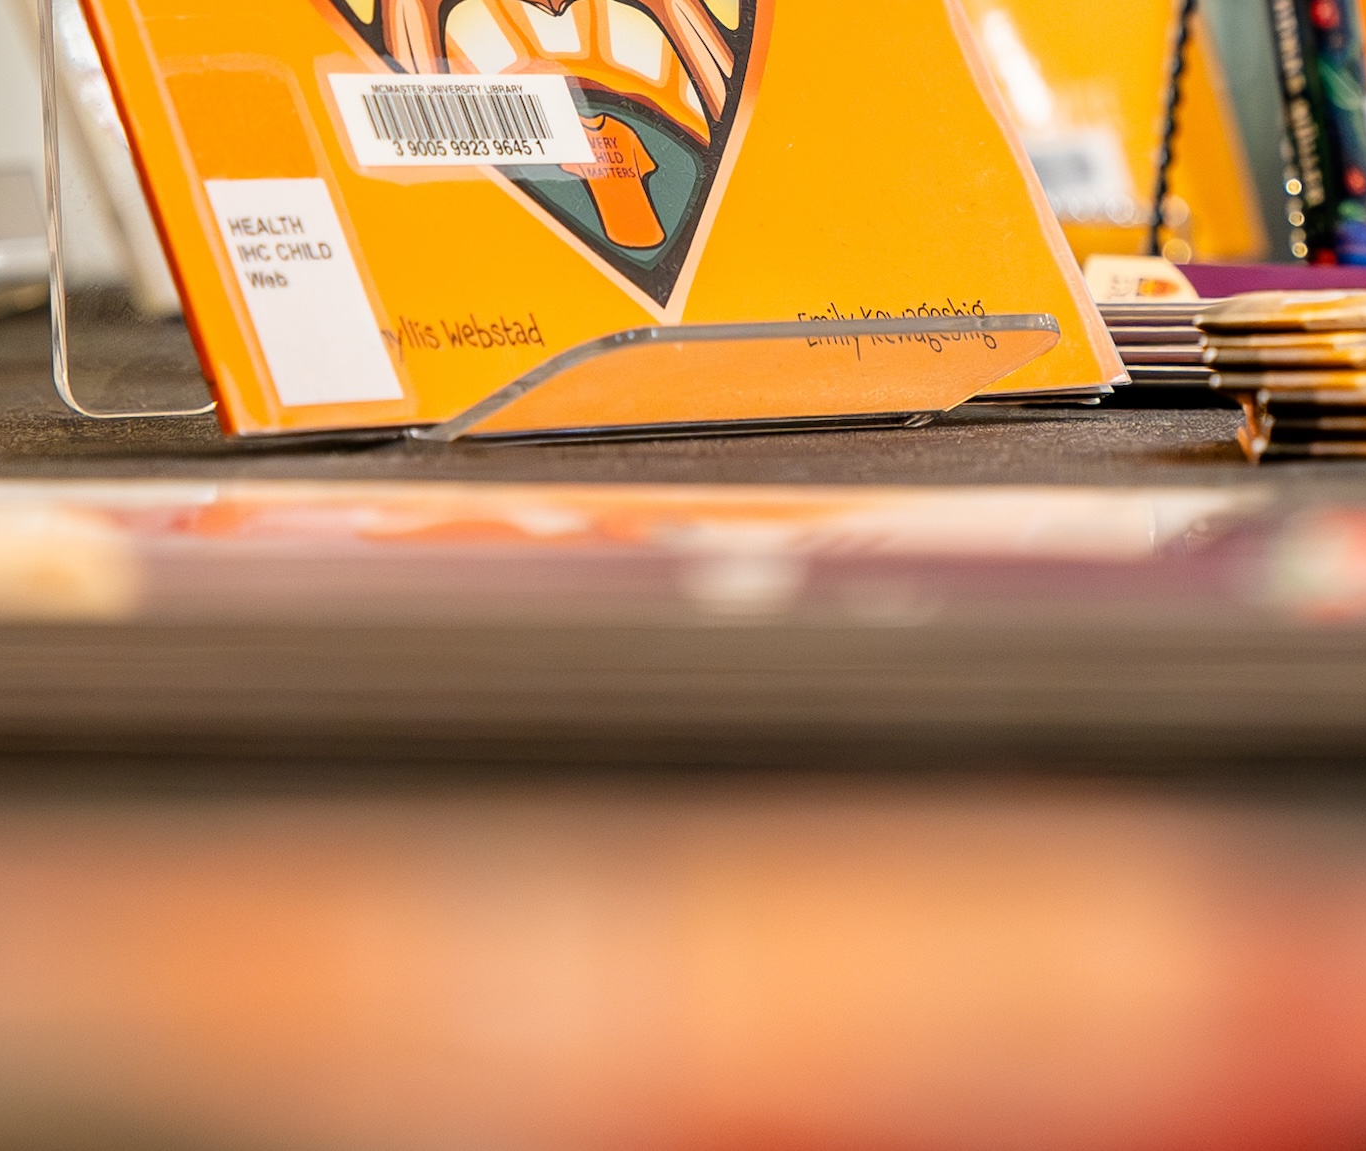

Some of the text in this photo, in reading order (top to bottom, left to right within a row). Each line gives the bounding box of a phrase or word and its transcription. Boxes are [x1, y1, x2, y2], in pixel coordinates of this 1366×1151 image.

[370, 84, 524, 94] MCMASTER UNIVERSITY LIBRARY
[392, 139, 545, 157] 3 9005 9923 9645 1
[588, 137, 618, 149] VERY
[595, 151, 624, 164] HILD
[587, 167, 637, 179] MATTERS
[227, 216, 306, 237] HEALTH
[237, 242, 333, 264] IHC CHILD
[246, 271, 289, 289] Web
[381, 312, 546, 363] yllis Webstad
[797, 301, 862, 362] Emily
